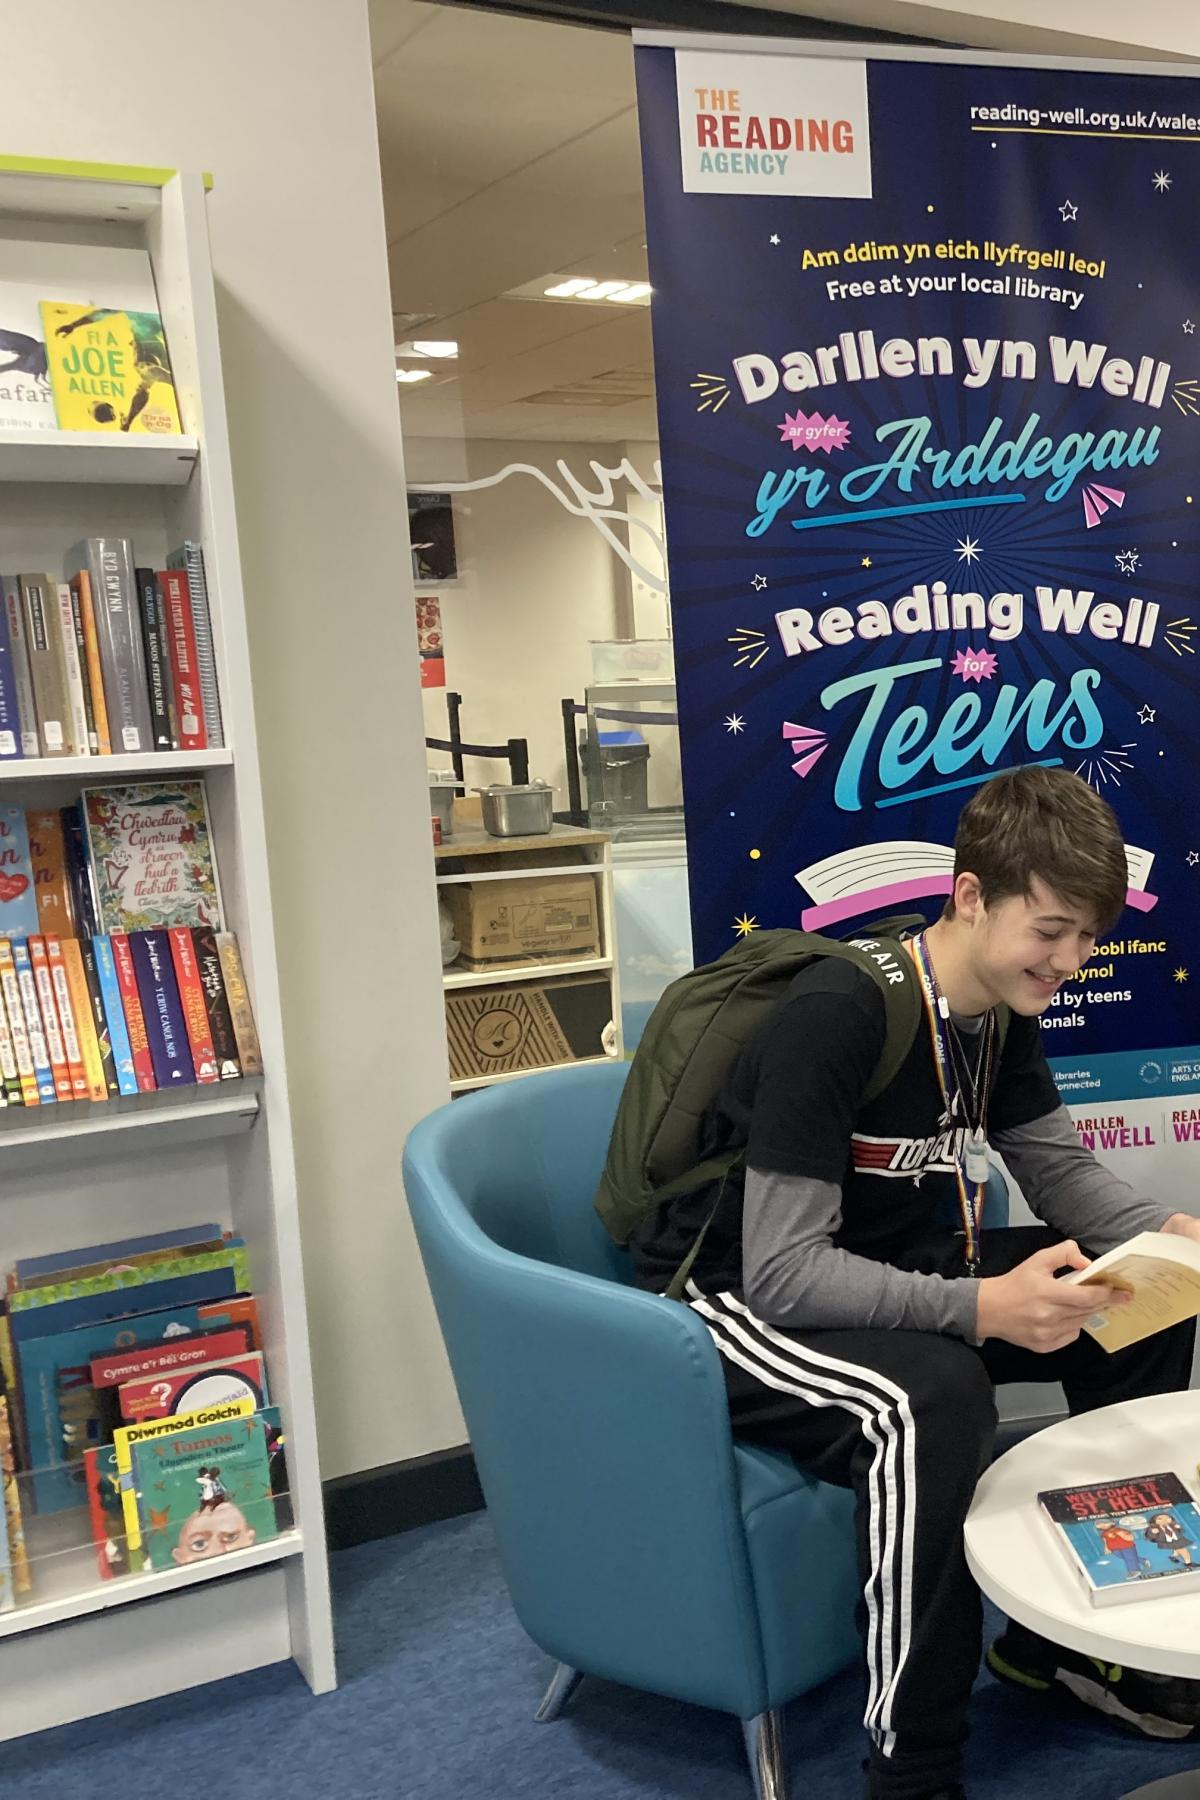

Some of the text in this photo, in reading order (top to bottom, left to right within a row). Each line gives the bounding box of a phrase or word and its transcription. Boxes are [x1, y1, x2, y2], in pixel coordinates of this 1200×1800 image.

[694, 88, 740, 112] THE
[696, 114, 854, 154] READING
[700, 151, 788, 176] AGENCY
[801, 240, 1106, 278] Am ddim yn eich llyfrgell leol
[826, 272, 1084, 310] Free at your local library
[88, 331, 118, 346] FI A
[62, 344, 125, 378] JOE
[731, 329, 1172, 409] Darllen yn Well
[69, 377, 125, 397] ALLEN
[788, 423, 843, 441] ar gyfer
[745, 412, 1162, 538] yr Arddegau
[103, 552, 123, 613] BYD GWYNN
[144, 586, 155, 624] GOLYGON
[774, 580, 1160, 657] Reading Well
[149, 632, 164, 715] MANON STEFFAN ROS
[963, 657, 988, 672] for
[820, 657, 1104, 812] Teens
[120, 809, 186, 830] Chwedlau
[128, 830, 178, 849] Cymru
[145, 864, 167, 879] hud
[1128, 940, 1166, 954] ifanc
[872, 952, 904, 986] AIR
[1064, 990, 1132, 1008] by teens
[1172, 1065, 1192, 1074] ARTS
[1100, 1127, 1155, 1149] WELL
[180, 1350, 206, 1362] Gron
[127, 1406, 241, 1442] Diwrnod Golchi
[1065, 1484, 1140, 1503] WELCOME
[1071, 1502, 1106, 1516] ST.
[1113, 1490, 1170, 1510] HELL
